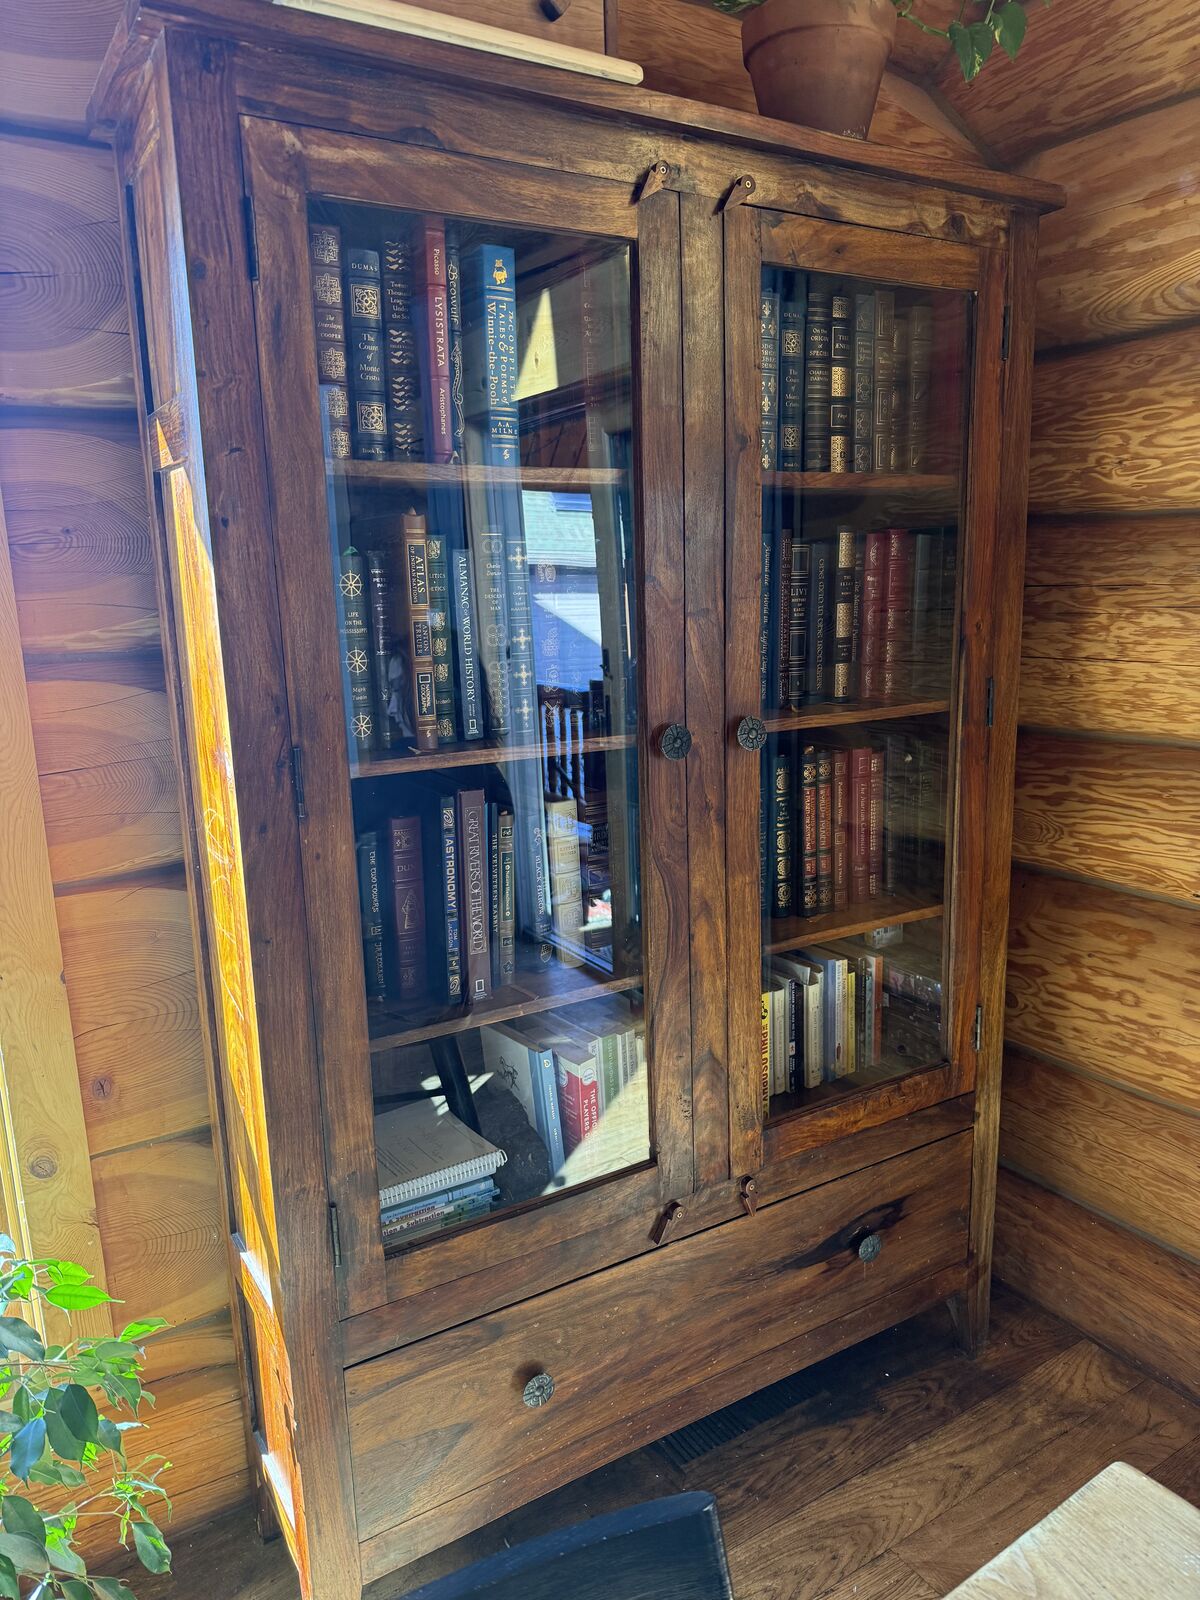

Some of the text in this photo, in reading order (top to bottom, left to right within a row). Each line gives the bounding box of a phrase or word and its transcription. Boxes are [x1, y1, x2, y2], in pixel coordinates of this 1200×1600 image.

[433, 248, 442, 276] Picasso
[447, 261, 460, 325] Beowulf
[361, 333, 375, 342] The
[435, 296, 446, 368] LYSISTRATA
[499, 302, 508, 340] TALES
[358, 342, 379, 352] Count
[366, 352, 374, 362] of
[487, 301, 500, 407] Winnie-the-Pooh
[498, 341, 509, 353] &
[359, 364, 380, 373] Monte
[500, 355, 508, 394] POEMS
[439, 387, 448, 437] Aristophanes
[490, 427, 518, 435] MILNE
[410, 546, 416, 554] OF
[416, 555, 427, 594] ATLAS
[458, 555, 470, 609] ALMANAC
[790, 588, 807, 596] LIVY
[422, 624, 430, 651] ANTON
[462, 616, 473, 655] WORLD
[465, 657, 476, 702] HISTORY
[468, 811, 481, 844] GREAT
[445, 838, 457, 909] ASTRONOMY
[469, 844, 482, 881] RIVERS
[369, 850, 380, 913] THE TWO TOWERS
[470, 880, 482, 896] OF
[471, 914, 485, 952] WORLD
[583, 1099, 591, 1131] PLAYERS
[406, 1210, 445, 1228] Subtraction
